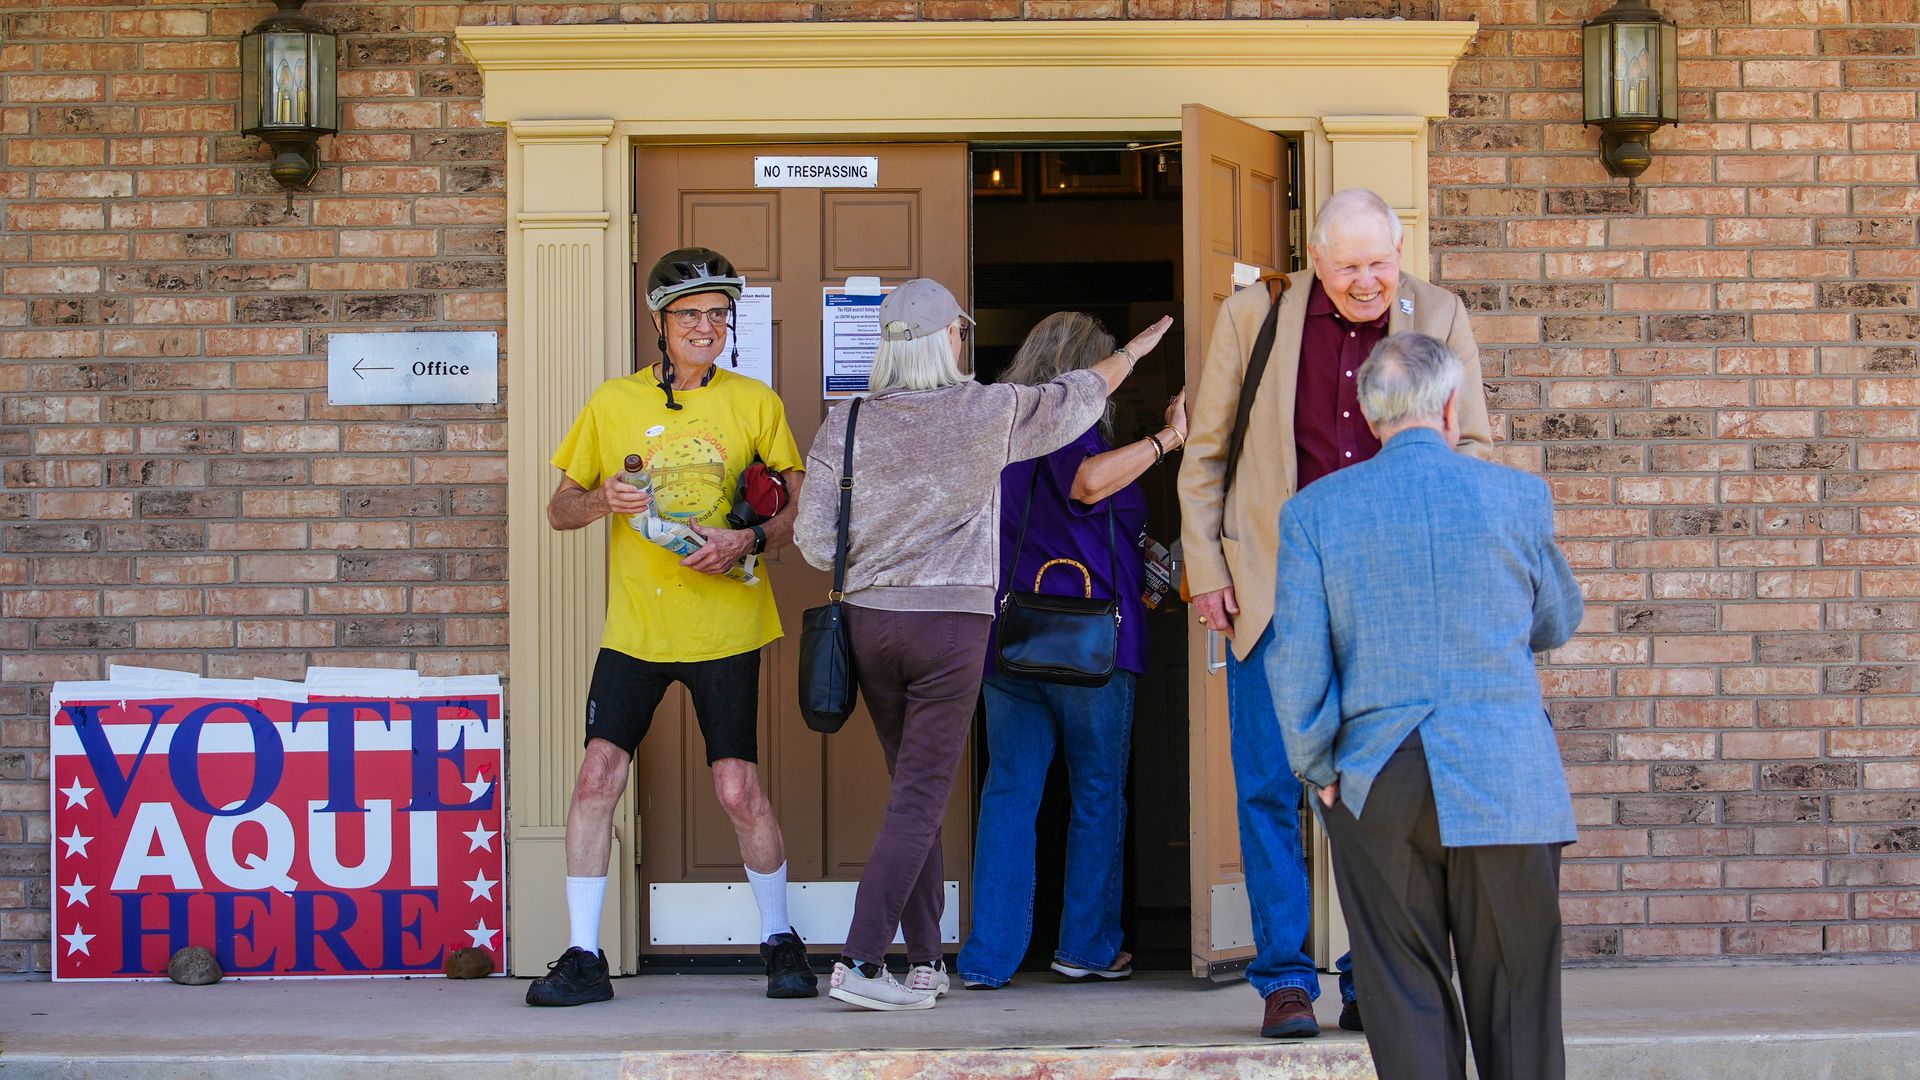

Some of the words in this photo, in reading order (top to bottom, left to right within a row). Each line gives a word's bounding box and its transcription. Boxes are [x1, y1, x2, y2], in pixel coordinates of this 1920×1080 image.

[763, 165, 781, 178] NO
[786, 165, 868, 178] TRESPASSING
[411, 361, 470, 377] Office
[60, 698, 498, 818] VOTE
[110, 799, 439, 898] AQUI
[111, 889, 445, 975] HERE
